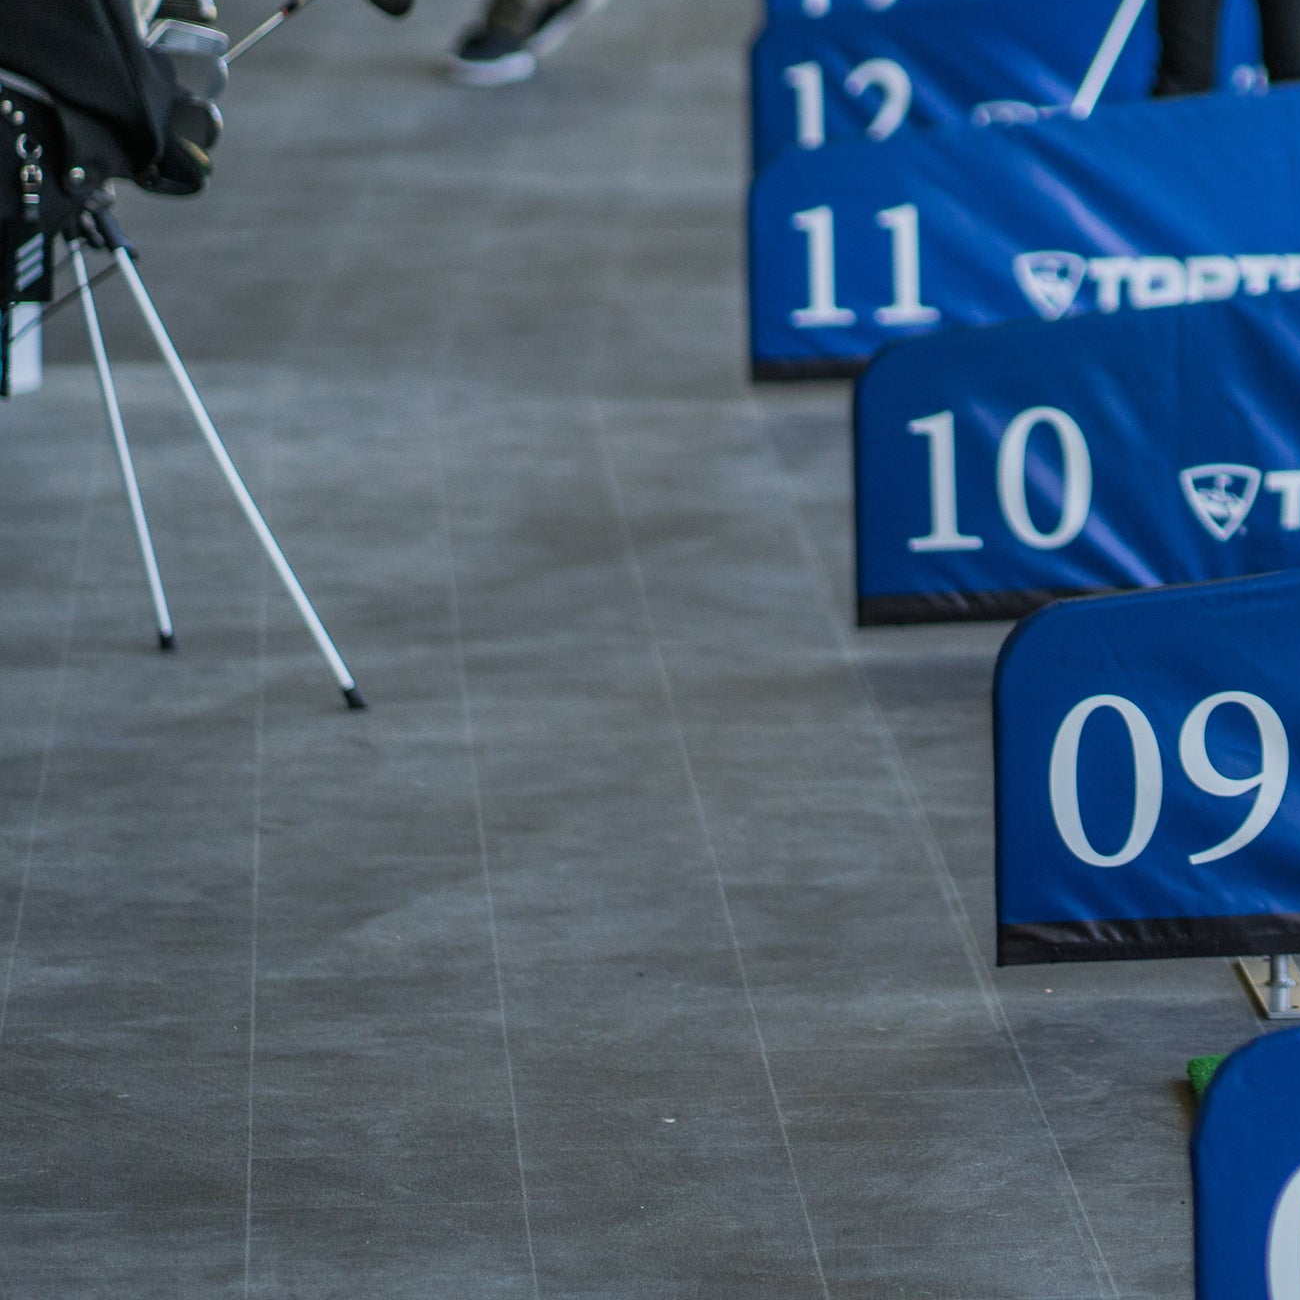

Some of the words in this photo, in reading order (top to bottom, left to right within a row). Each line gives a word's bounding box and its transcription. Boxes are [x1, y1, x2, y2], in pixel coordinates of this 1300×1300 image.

[785, 58, 912, 149] 12
[790, 203, 940, 327] 11
[909, 406, 1093, 552] 10
[1048, 690, 1290, 868] 09
